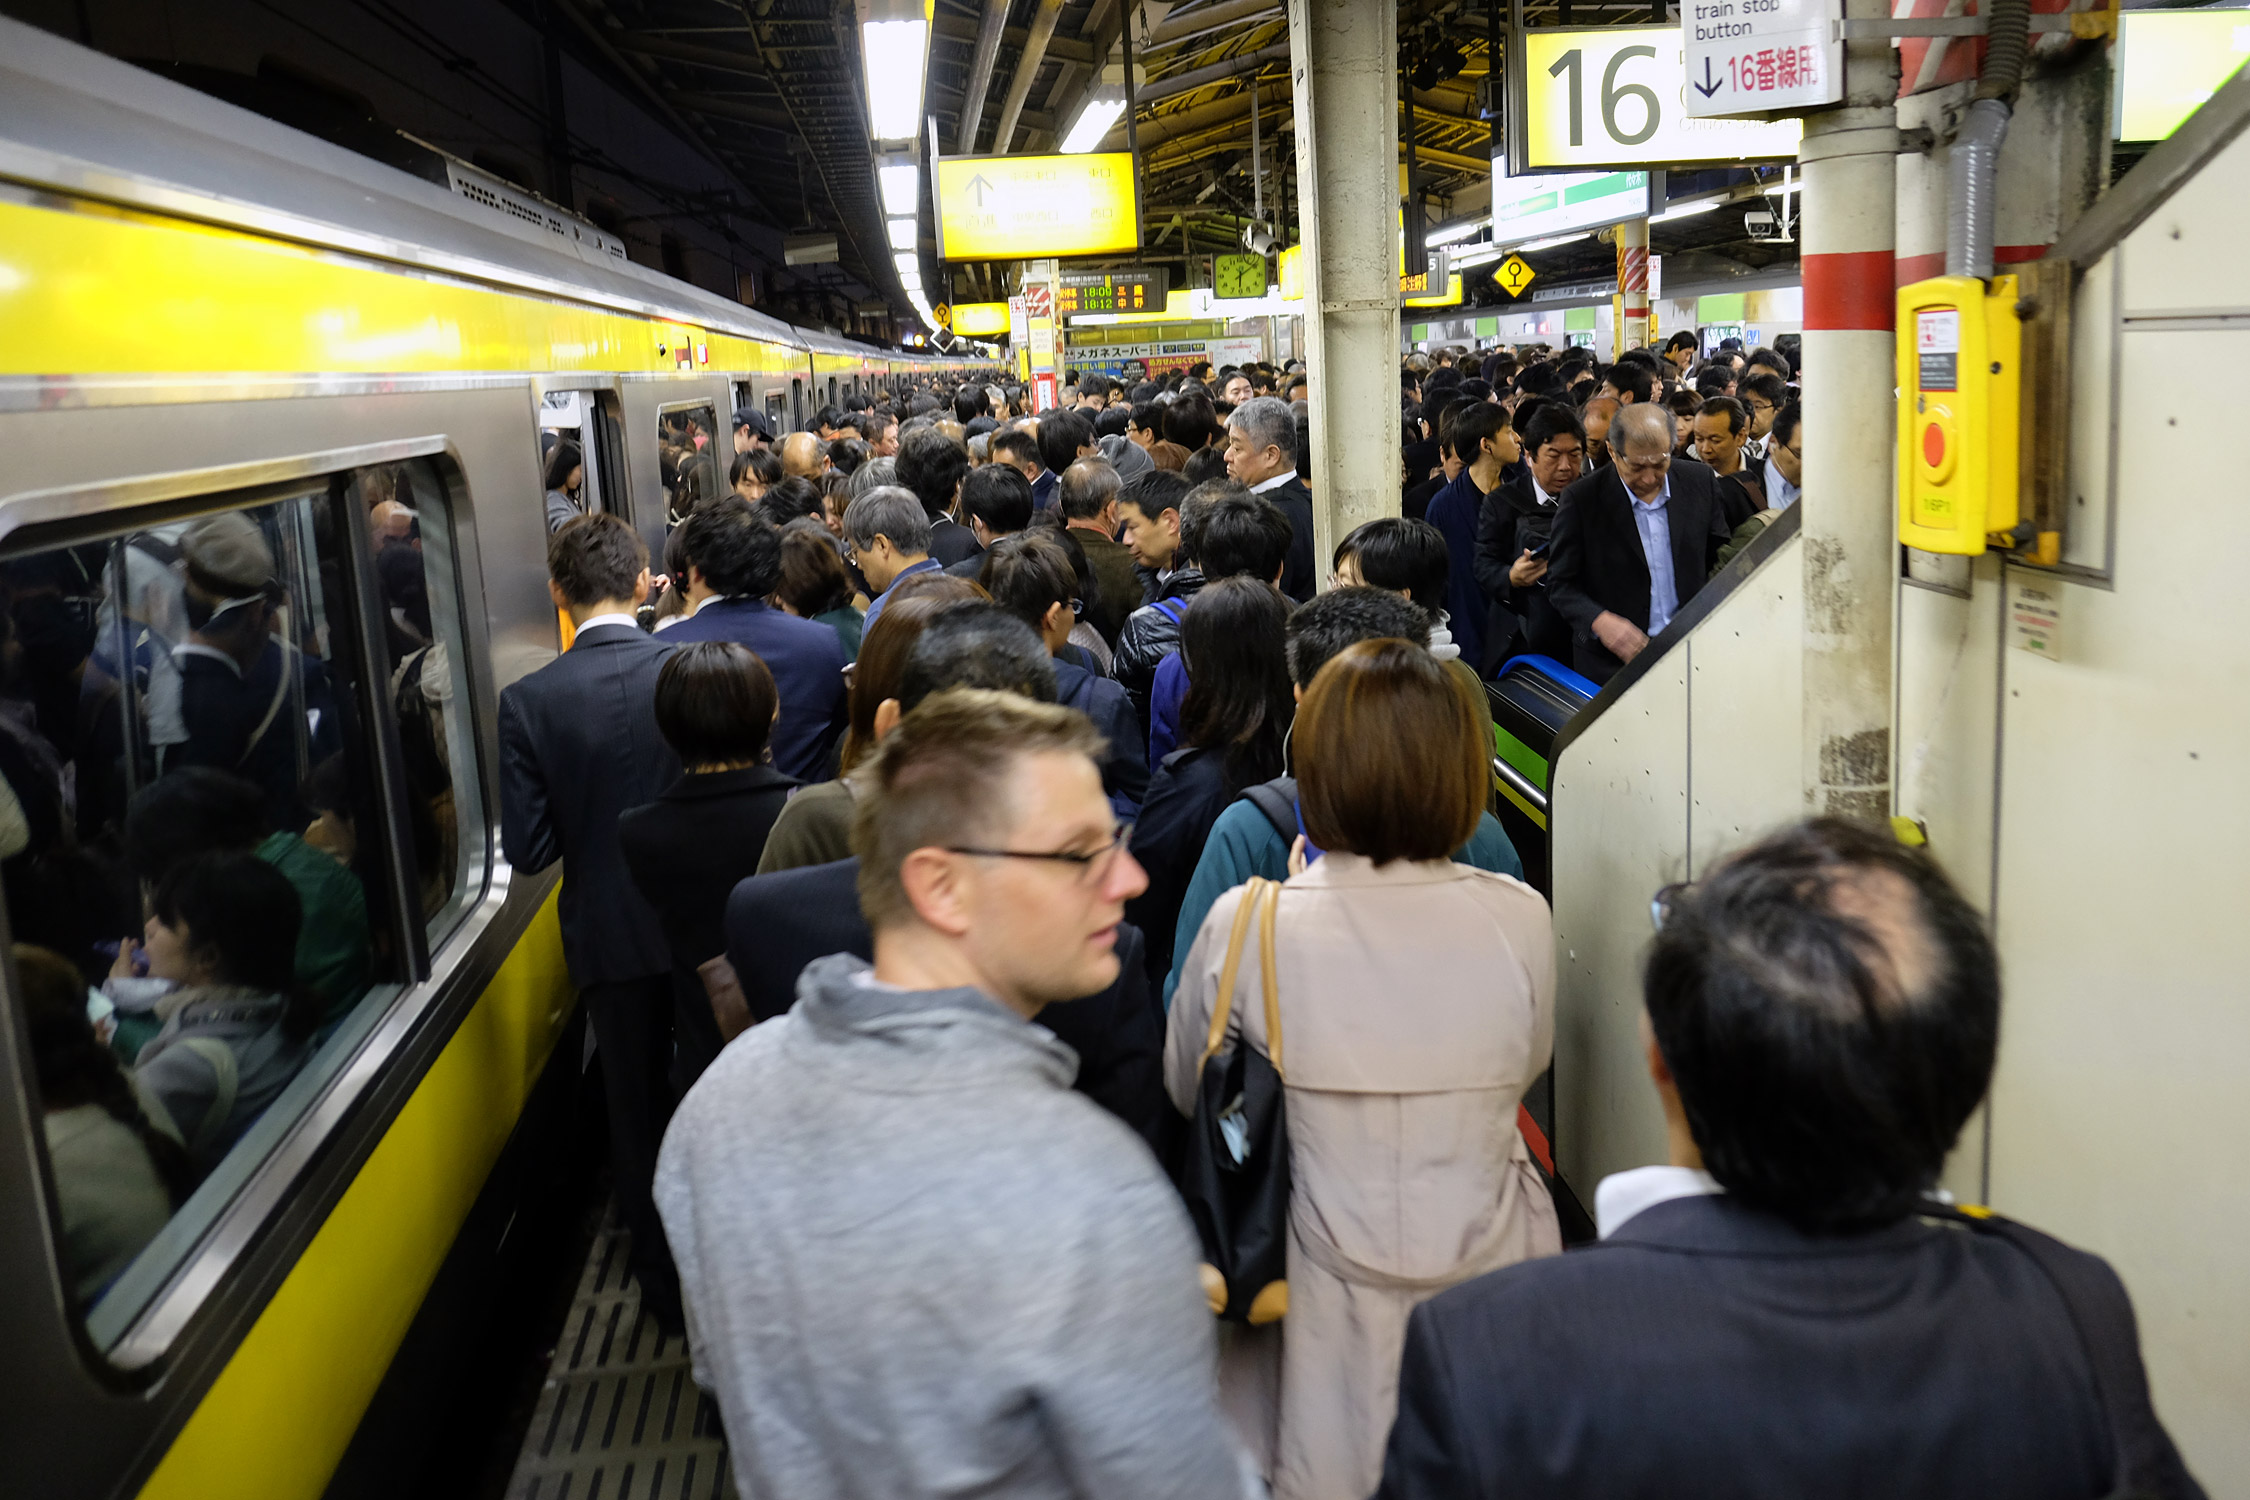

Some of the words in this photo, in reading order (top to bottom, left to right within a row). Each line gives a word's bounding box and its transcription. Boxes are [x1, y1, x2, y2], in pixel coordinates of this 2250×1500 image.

[1695, 1, 1734, 20] train
[1742, 0, 1780, 15] stop
[1695, 21, 1753, 41] button
[1728, 45, 1818, 93] 16番線用
[1547, 44, 1662, 147] 16
[1084, 298, 1113, 310] 18:12
[1076, 345, 1148, 359] メガネスーパー
